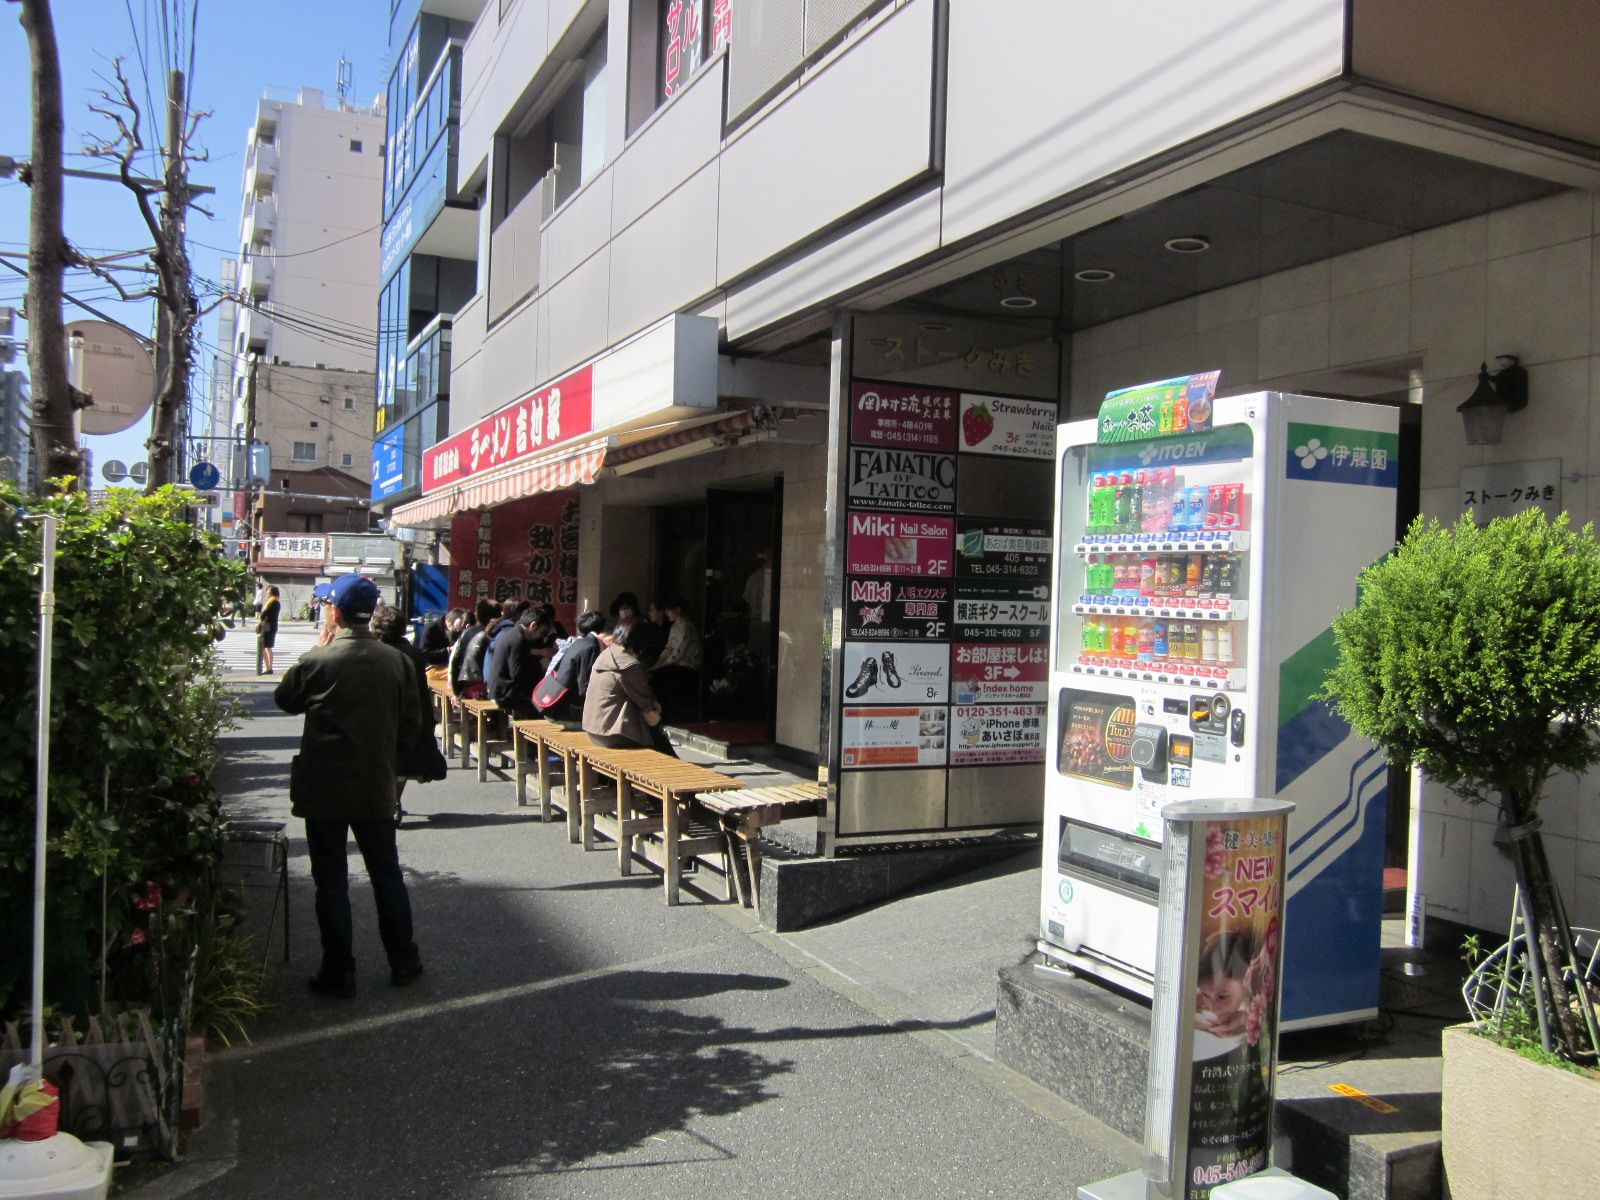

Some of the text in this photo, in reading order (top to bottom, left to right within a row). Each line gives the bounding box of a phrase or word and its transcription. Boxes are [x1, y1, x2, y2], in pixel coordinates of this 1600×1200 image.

[992, 400, 1055, 421] Strawberry
[1032, 420, 1054, 432] Nails
[1005, 431, 1021, 443] 3F
[1329, 443, 1388, 471] 伊藤園
[852, 449, 955, 488] FANATIC
[866, 481, 940, 500] TATTOO
[1464, 485, 1555, 505] ストークみき
[853, 498, 952, 511] www.fanatic-tattoo.com
[853, 515, 948, 537] Miki Nail Salon
[1004, 553, 1020, 563] 405
[928, 559, 948, 575] 2F
[971, 564, 984, 573] TEL
[852, 580, 892, 603] Miki
[905, 602, 938, 616] 専門店
[957, 602, 1048, 622] 横浜ギタースクール
[926, 621, 946, 638] 2F
[984, 665, 1003, 681] 3F
[1009, 684, 1034, 693] home
[957, 706, 1033, 717] 0120-351-463
[986, 717, 1040, 729] iPhone 修理
[1235, 856, 1275, 882] NEW
